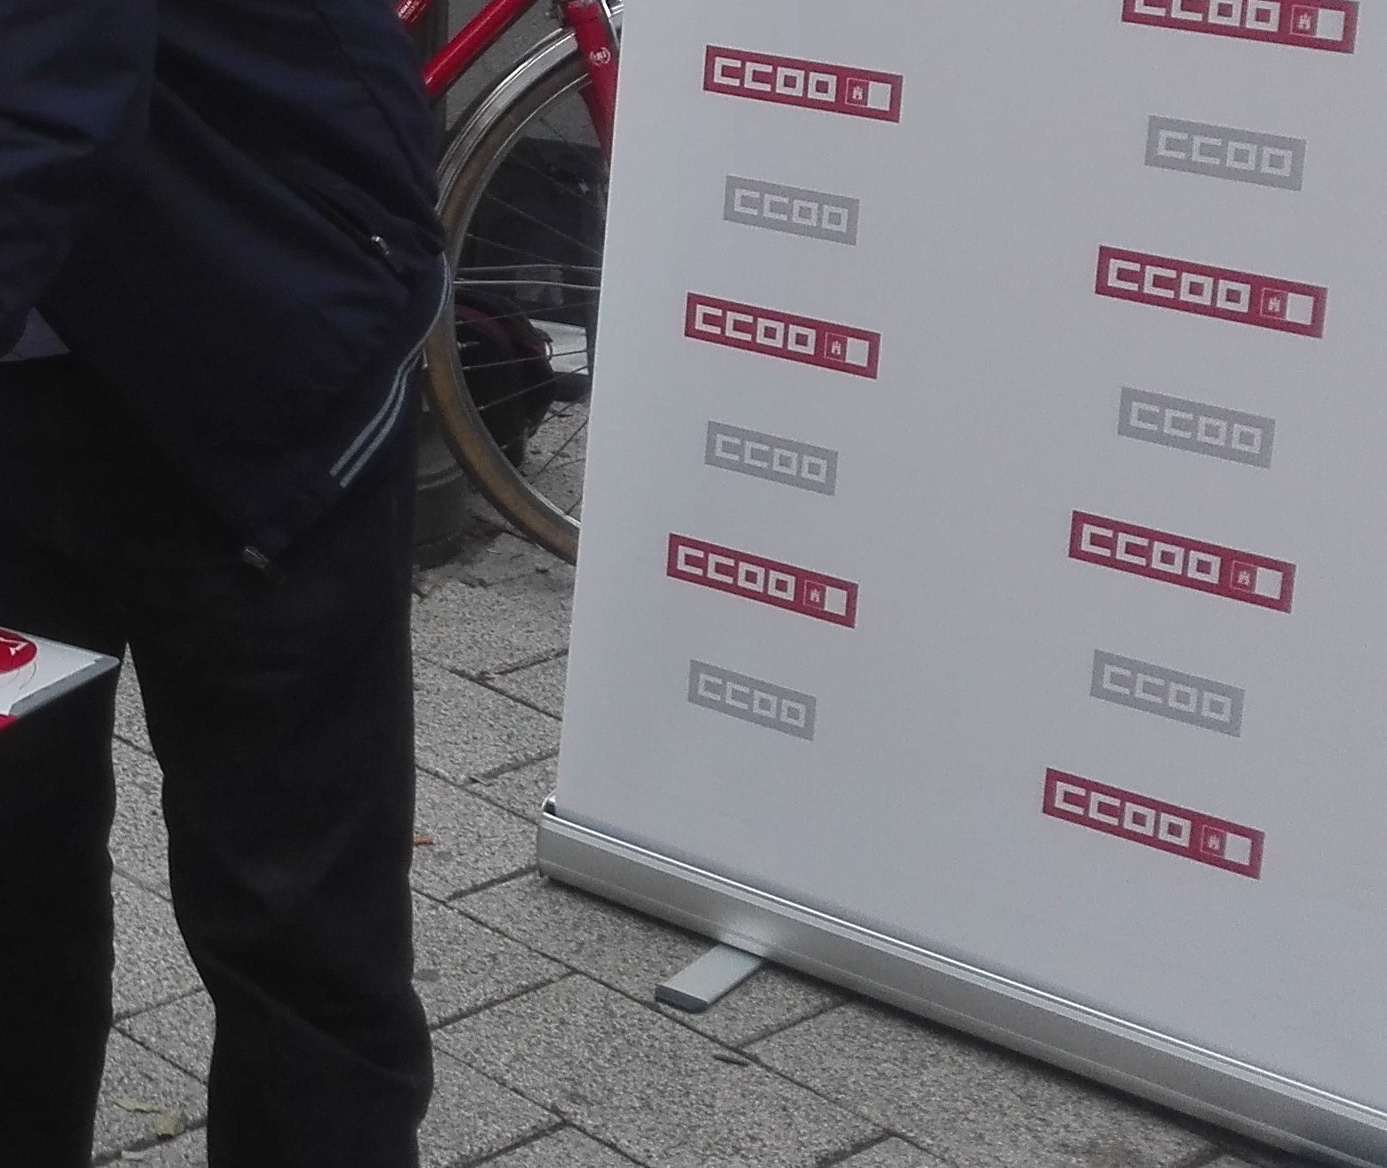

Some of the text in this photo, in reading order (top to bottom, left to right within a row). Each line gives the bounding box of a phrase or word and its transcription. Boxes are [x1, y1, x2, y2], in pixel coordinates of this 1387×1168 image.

[714, 57, 837, 101] CCOO
[1157, 129, 1293, 176] CCOO
[734, 188, 849, 233] CCOO
[1107, 257, 1252, 309] CCOO
[695, 305, 816, 354] CCOO
[1131, 402, 1264, 454] CCOO
[715, 435, 828, 482] CCOO
[677, 545, 795, 600] CCOO
[1081, 523, 1221, 583] CCOO
[697, 673, 806, 727] CCOO
[1102, 664, 1233, 722] CCOO
[1054, 781, 1191, 844] CCOO
